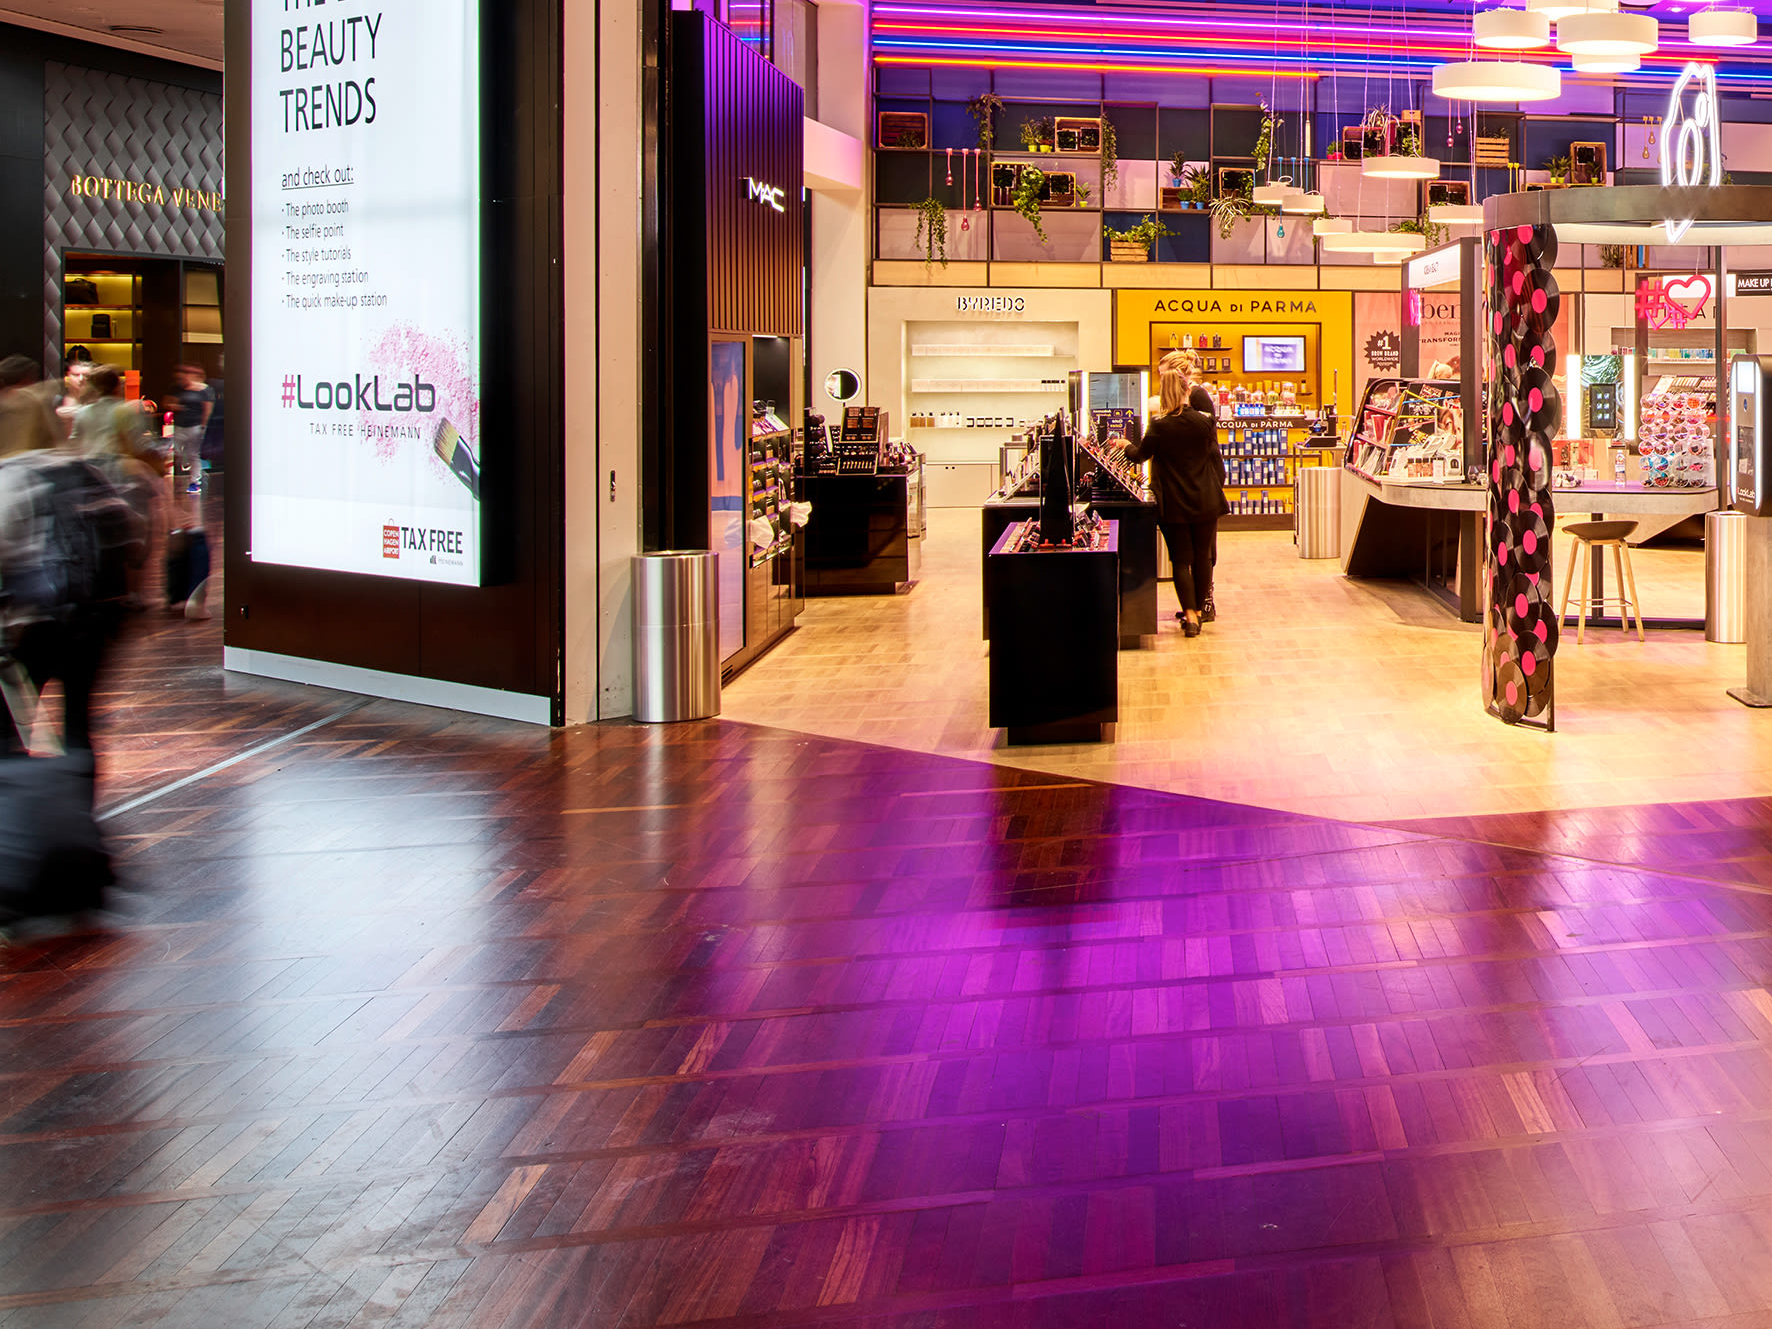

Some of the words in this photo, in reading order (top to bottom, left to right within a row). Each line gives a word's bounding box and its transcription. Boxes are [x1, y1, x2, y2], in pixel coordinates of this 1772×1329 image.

[280, 12, 383, 73] BEAUTY
[279, 77, 377, 133] TRENDS
[281, 168, 300, 188] and
[303, 165, 331, 185] check
[71, 174, 164, 206] BOTTEGA
[301, 203, 325, 219] photo
[326, 198, 349, 215] booth
[301, 223, 322, 239] selfie
[323, 222, 344, 240] point
[301, 246, 320, 265] style
[321, 244, 352, 263] tutorials
[301, 269, 340, 288] engraving
[341, 268, 369, 285] station
[1738, 278, 1759, 288] MAKE
[1760, 278, 1769, 288] UP
[301, 292, 322, 309] quick
[323, 291, 358, 310] make-up
[360, 291, 388, 308] station
[957, 296, 1026, 312] BYREDO
[1154, 299, 1223, 314] ACQUA
[1250, 300, 1318, 314] PARMA
[1377, 336, 1391, 350] #1
[282, 373, 436, 413] #LookLab
[309, 422, 328, 436] TAX
[332, 424, 354, 437] FREE
[360, 425, 421, 440] HEINEMANN
[1215, 421, 1248, 430] ACQUA
[1266, 421, 1294, 429] PARMA
[401, 526, 427, 551] TAX
[429, 529, 464, 555] FREE
